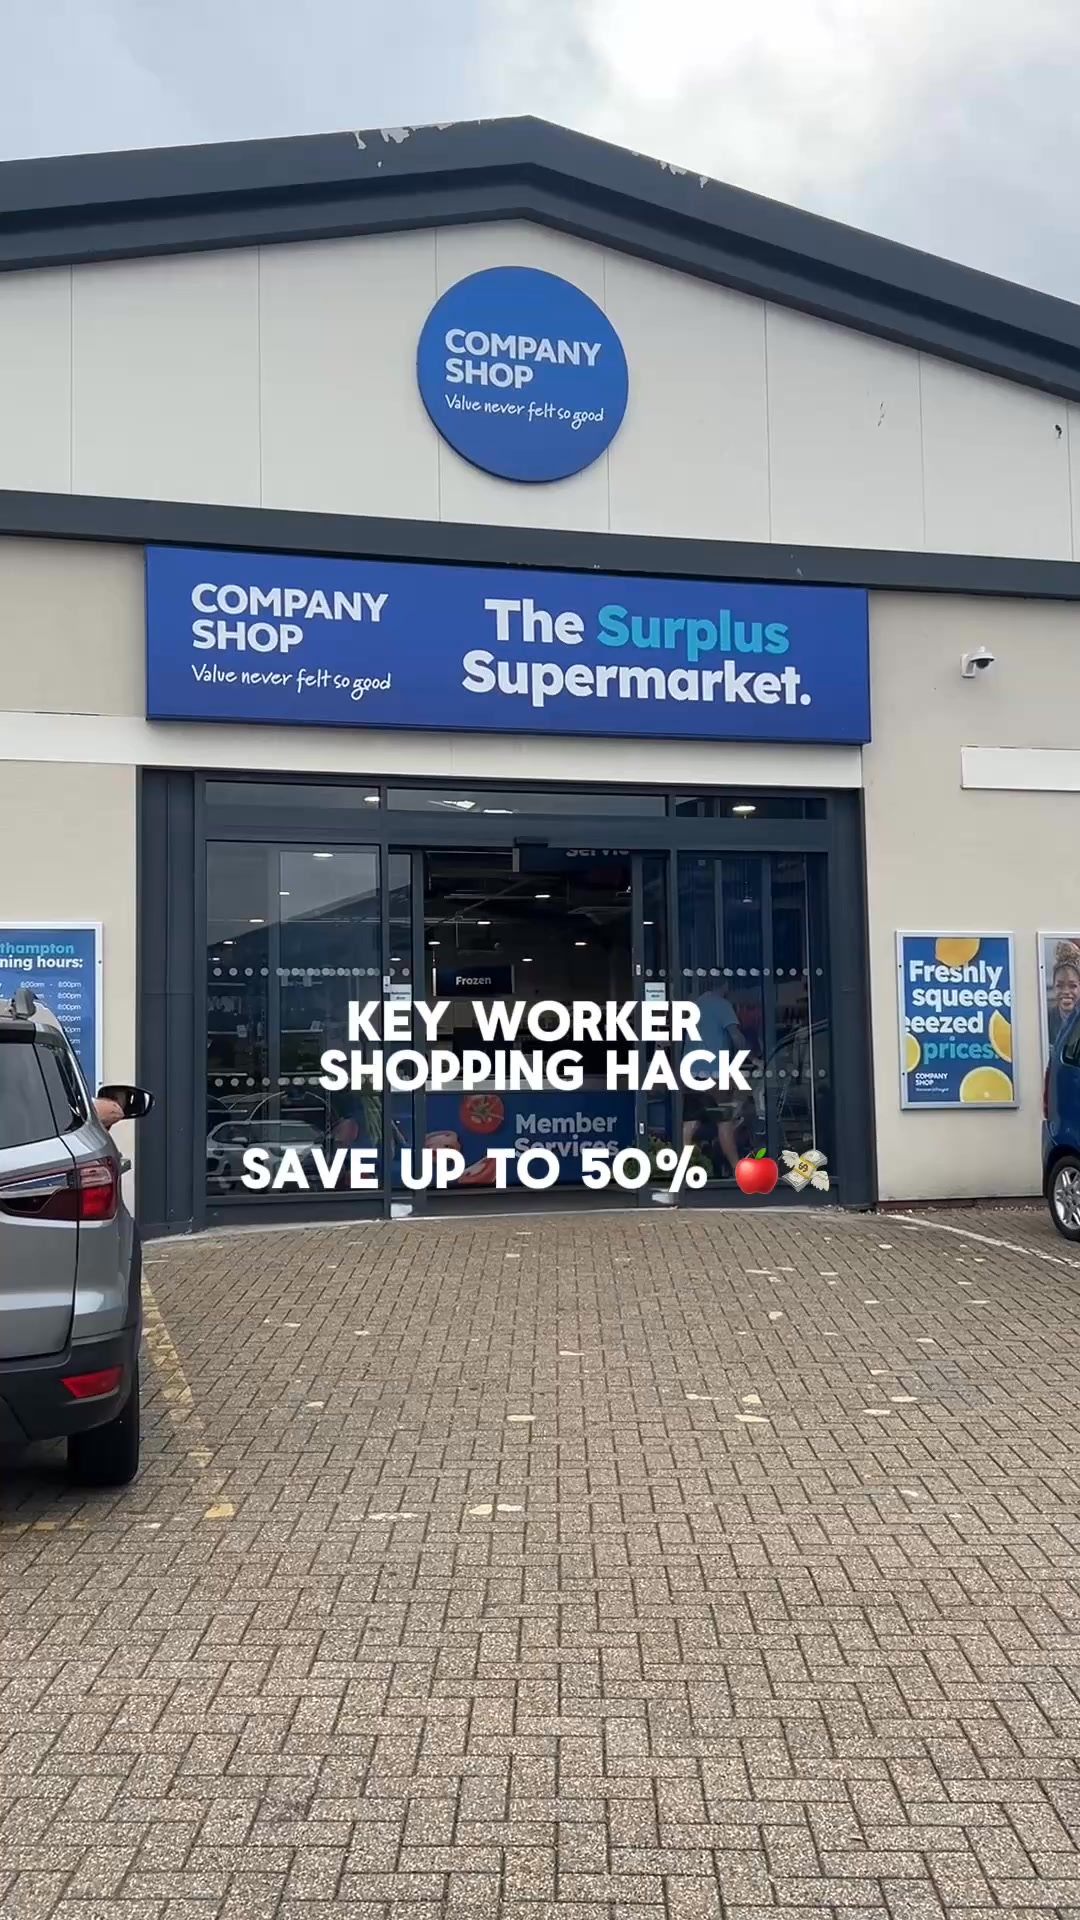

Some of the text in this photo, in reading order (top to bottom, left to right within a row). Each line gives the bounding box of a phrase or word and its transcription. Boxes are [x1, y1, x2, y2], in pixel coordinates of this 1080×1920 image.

[444, 328, 602, 367] COMPANY
[445, 358, 534, 389] SHOP
[444, 393, 604, 430] Value never felt so good
[191, 583, 389, 623] COMPANY
[192, 619, 304, 653] SHOP
[484, 598, 790, 662] The Surplus
[191, 663, 391, 701] Value never felt so good
[461, 650, 812, 708] Supermarket.
[0, 954, 84, 971] ning hours:
[909, 960, 1003, 989] Freshly
[455, 976, 492, 986] Frozen
[915, 1072, 949, 1080] COMPANY
[515, 1111, 618, 1134] Member
